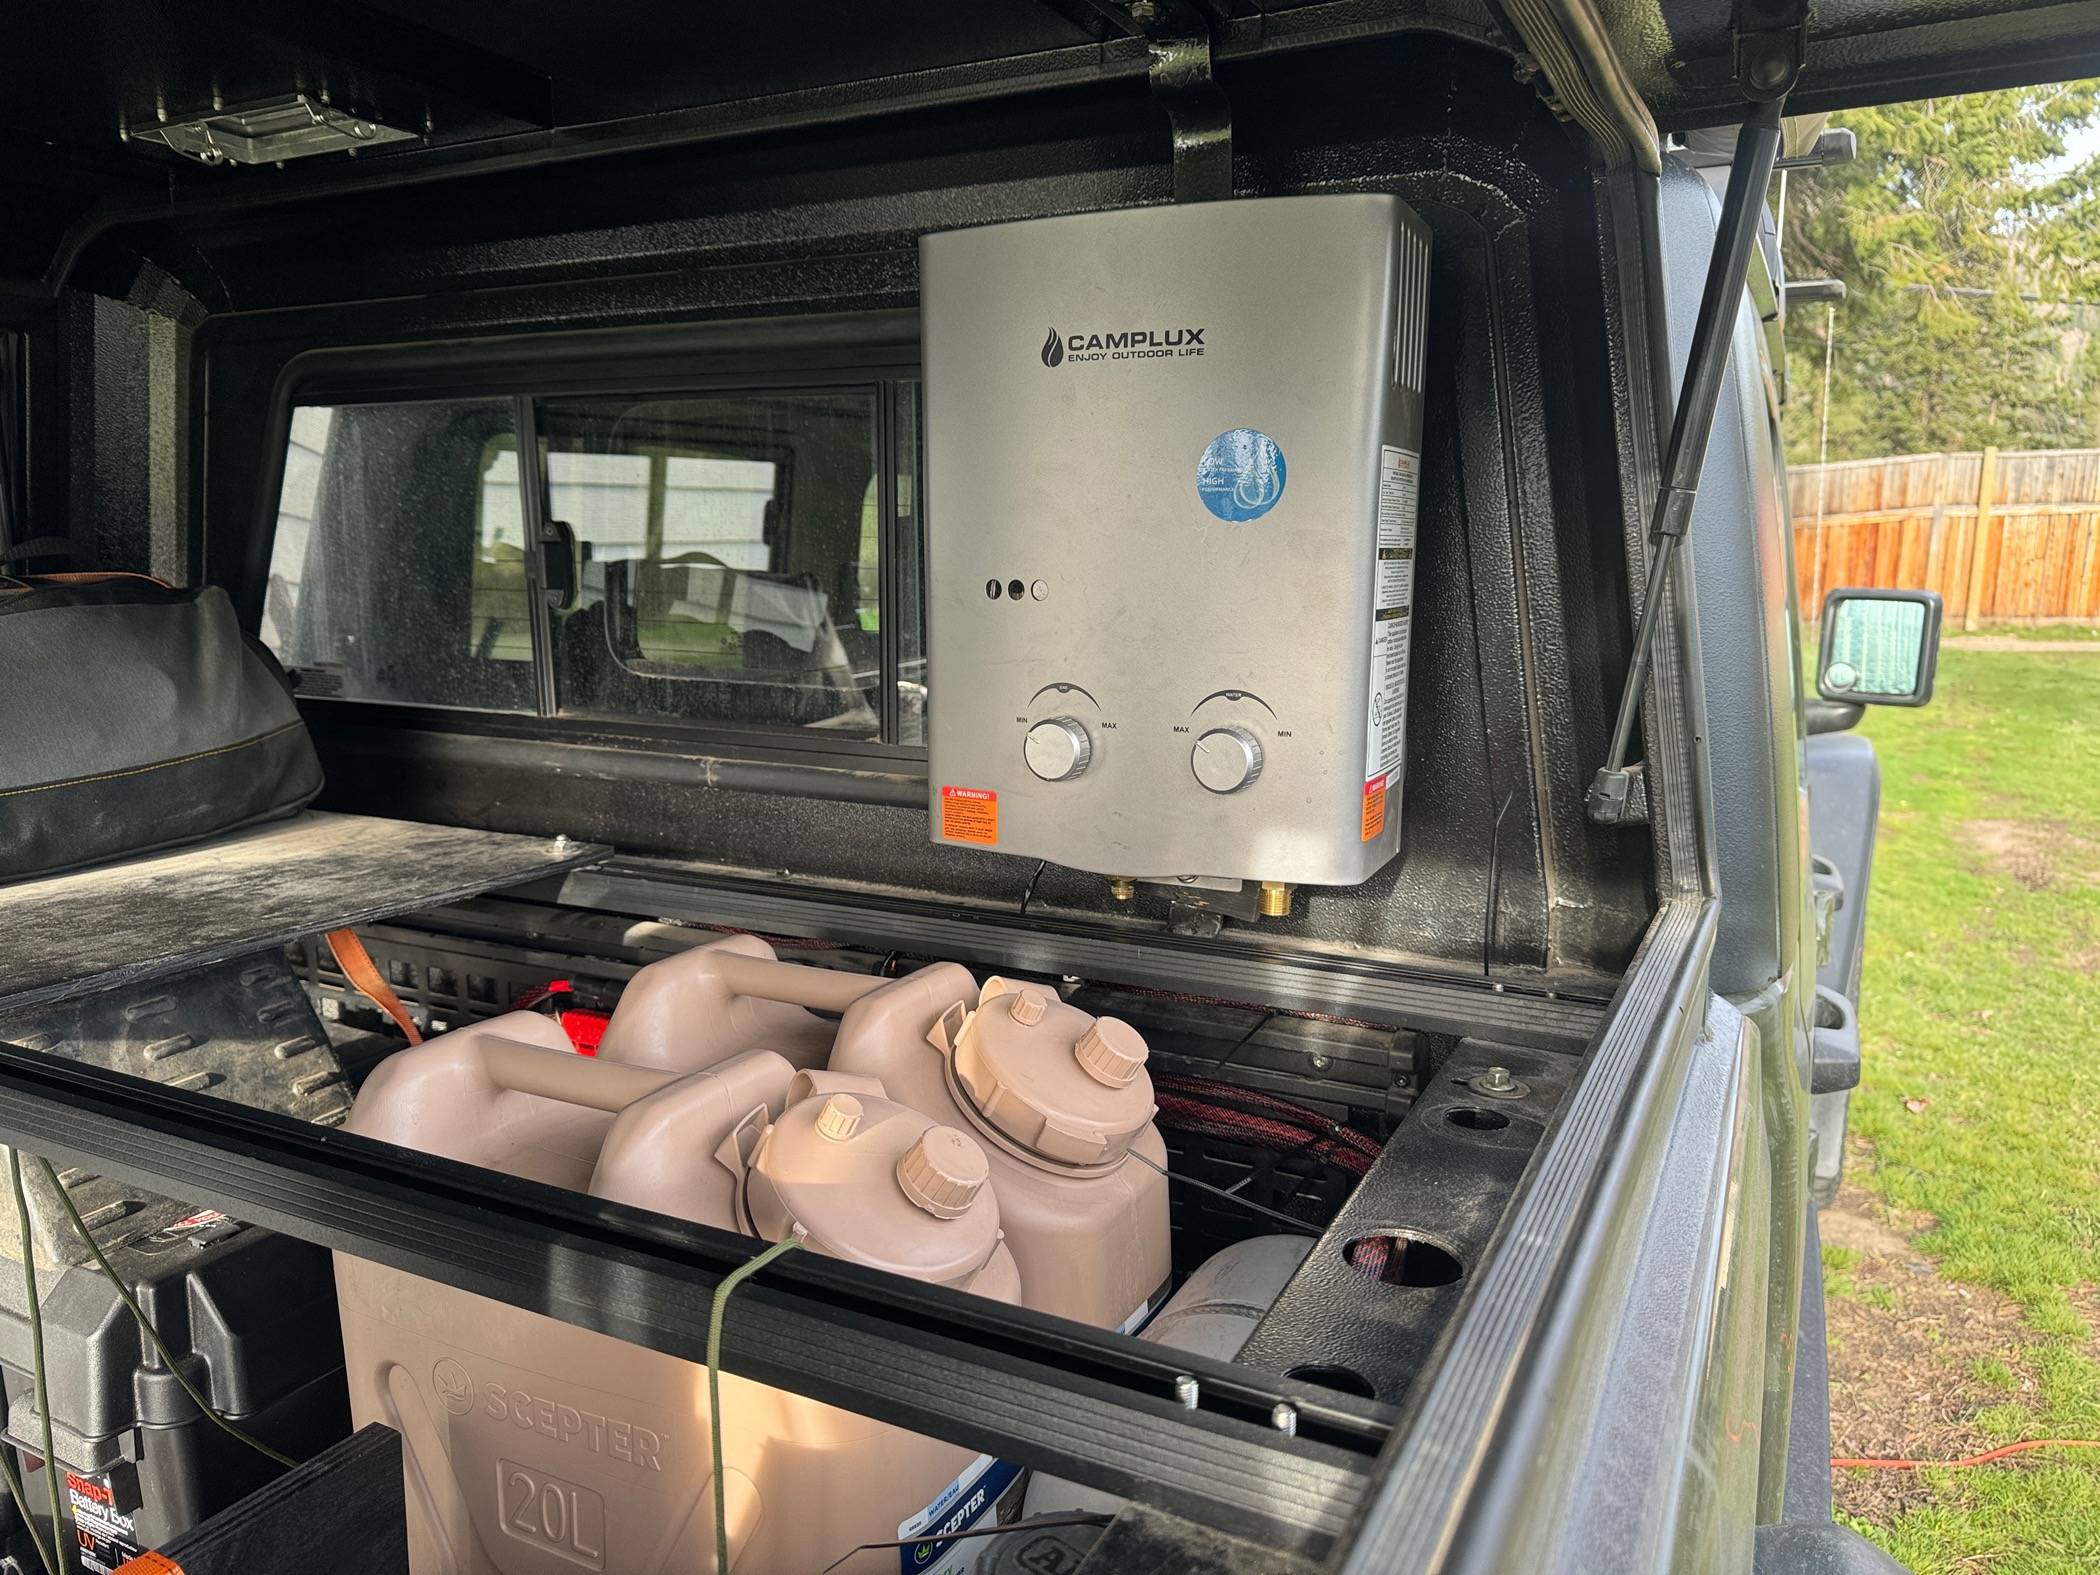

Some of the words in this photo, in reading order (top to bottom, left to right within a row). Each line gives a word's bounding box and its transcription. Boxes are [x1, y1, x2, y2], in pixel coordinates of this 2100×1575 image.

[1068, 328, 1205, 351] CAMPLUX
[1068, 352, 1107, 362] ENJOY
[1112, 350, 1173, 360] OUTDOOR
[1178, 347, 1205, 357] LIFE
[1173, 726, 1190, 734] MAX
[1277, 730, 1292, 738] MIN
[956, 790, 990, 800] WARNING!
[484, 1381, 662, 1472] SCEPTER
[69, 1489, 109, 1522] Battery
[111, 1506, 135, 1532] Box
[508, 1471, 600, 1559] 20L
[76, 1529, 96, 1551] UV
